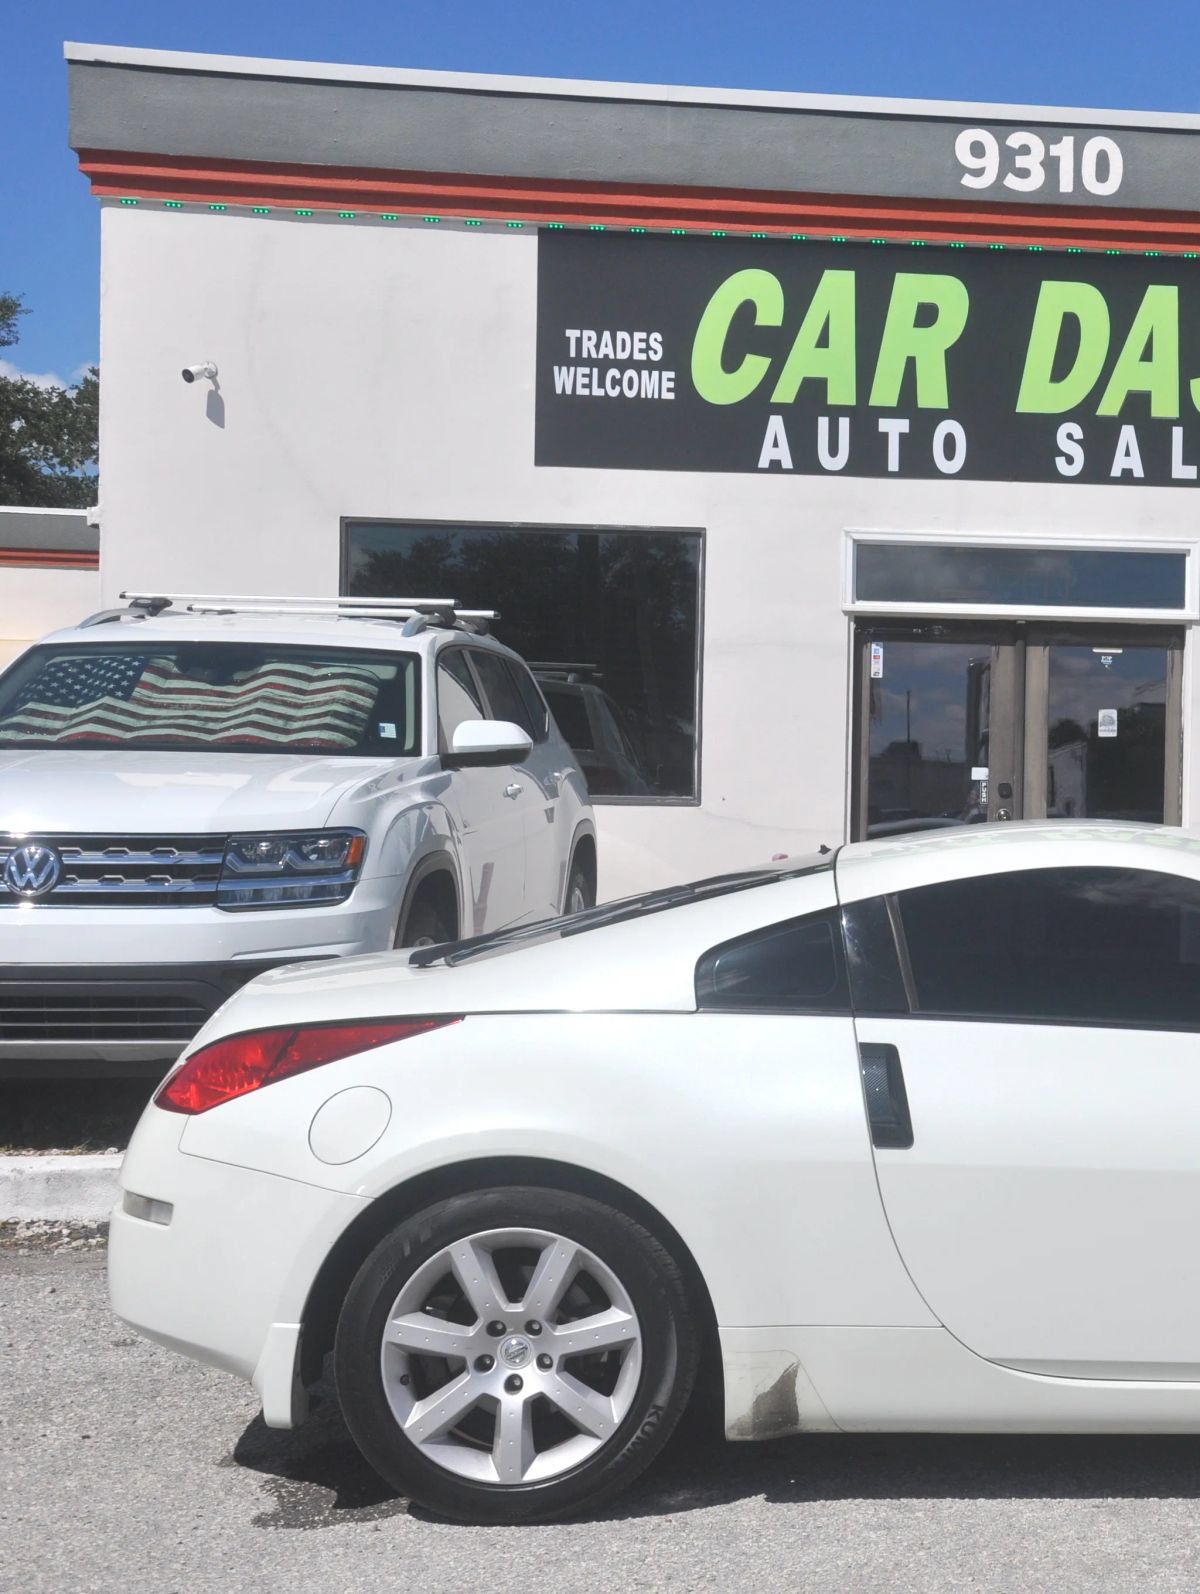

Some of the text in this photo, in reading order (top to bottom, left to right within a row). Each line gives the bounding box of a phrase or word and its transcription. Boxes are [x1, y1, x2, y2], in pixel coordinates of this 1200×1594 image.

[954, 127, 1124, 197] 9310
[565, 328, 664, 362] TRADES
[692, 269, 969, 408] CAR
[553, 365, 676, 400] WELCOME
[757, 414, 968, 475] AUTO
